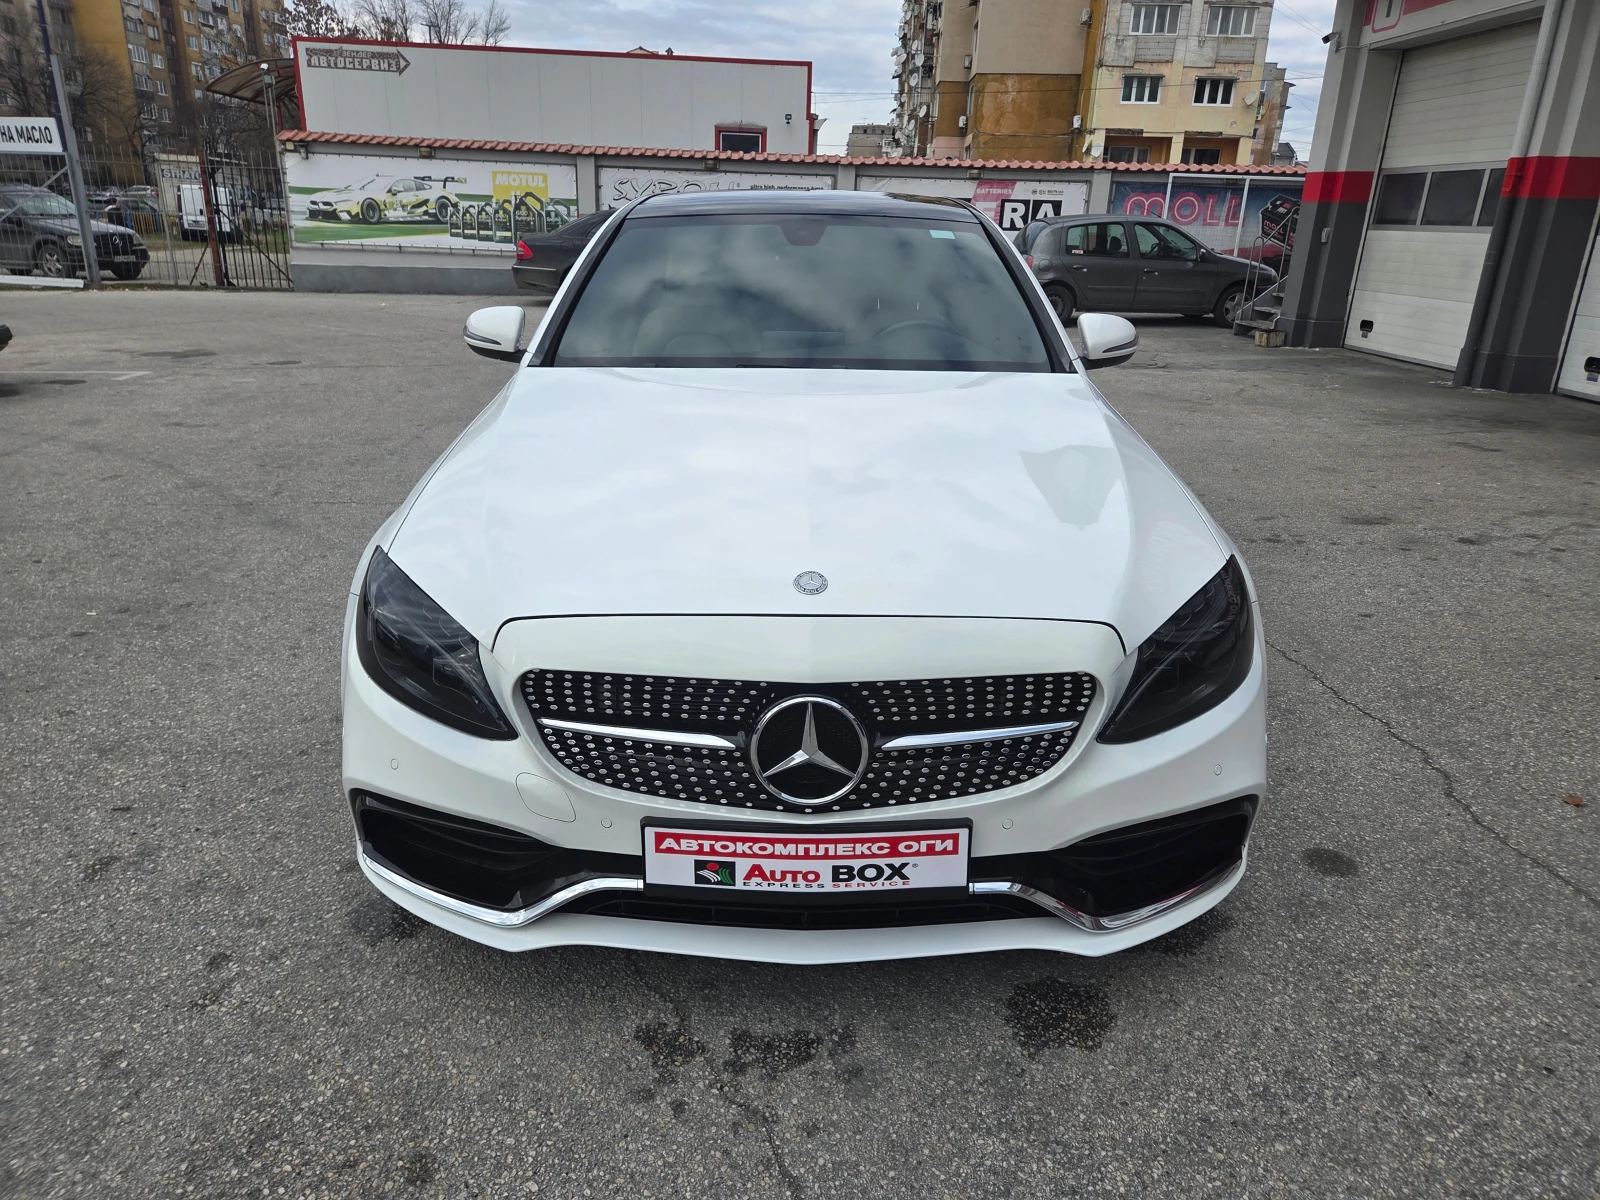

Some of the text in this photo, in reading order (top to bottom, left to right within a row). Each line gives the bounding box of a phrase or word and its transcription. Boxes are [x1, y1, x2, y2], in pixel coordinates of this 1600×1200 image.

[310, 56, 397, 71] АВТОСЕРВИЗ
[0, 125, 53, 144] НА МАСЛО
[495, 173, 546, 187] MOTUL
[659, 838, 953, 856] АВТОКОМПЛЕКС ОГИ
[743, 880, 910, 889] EXPRESS SERVICE
